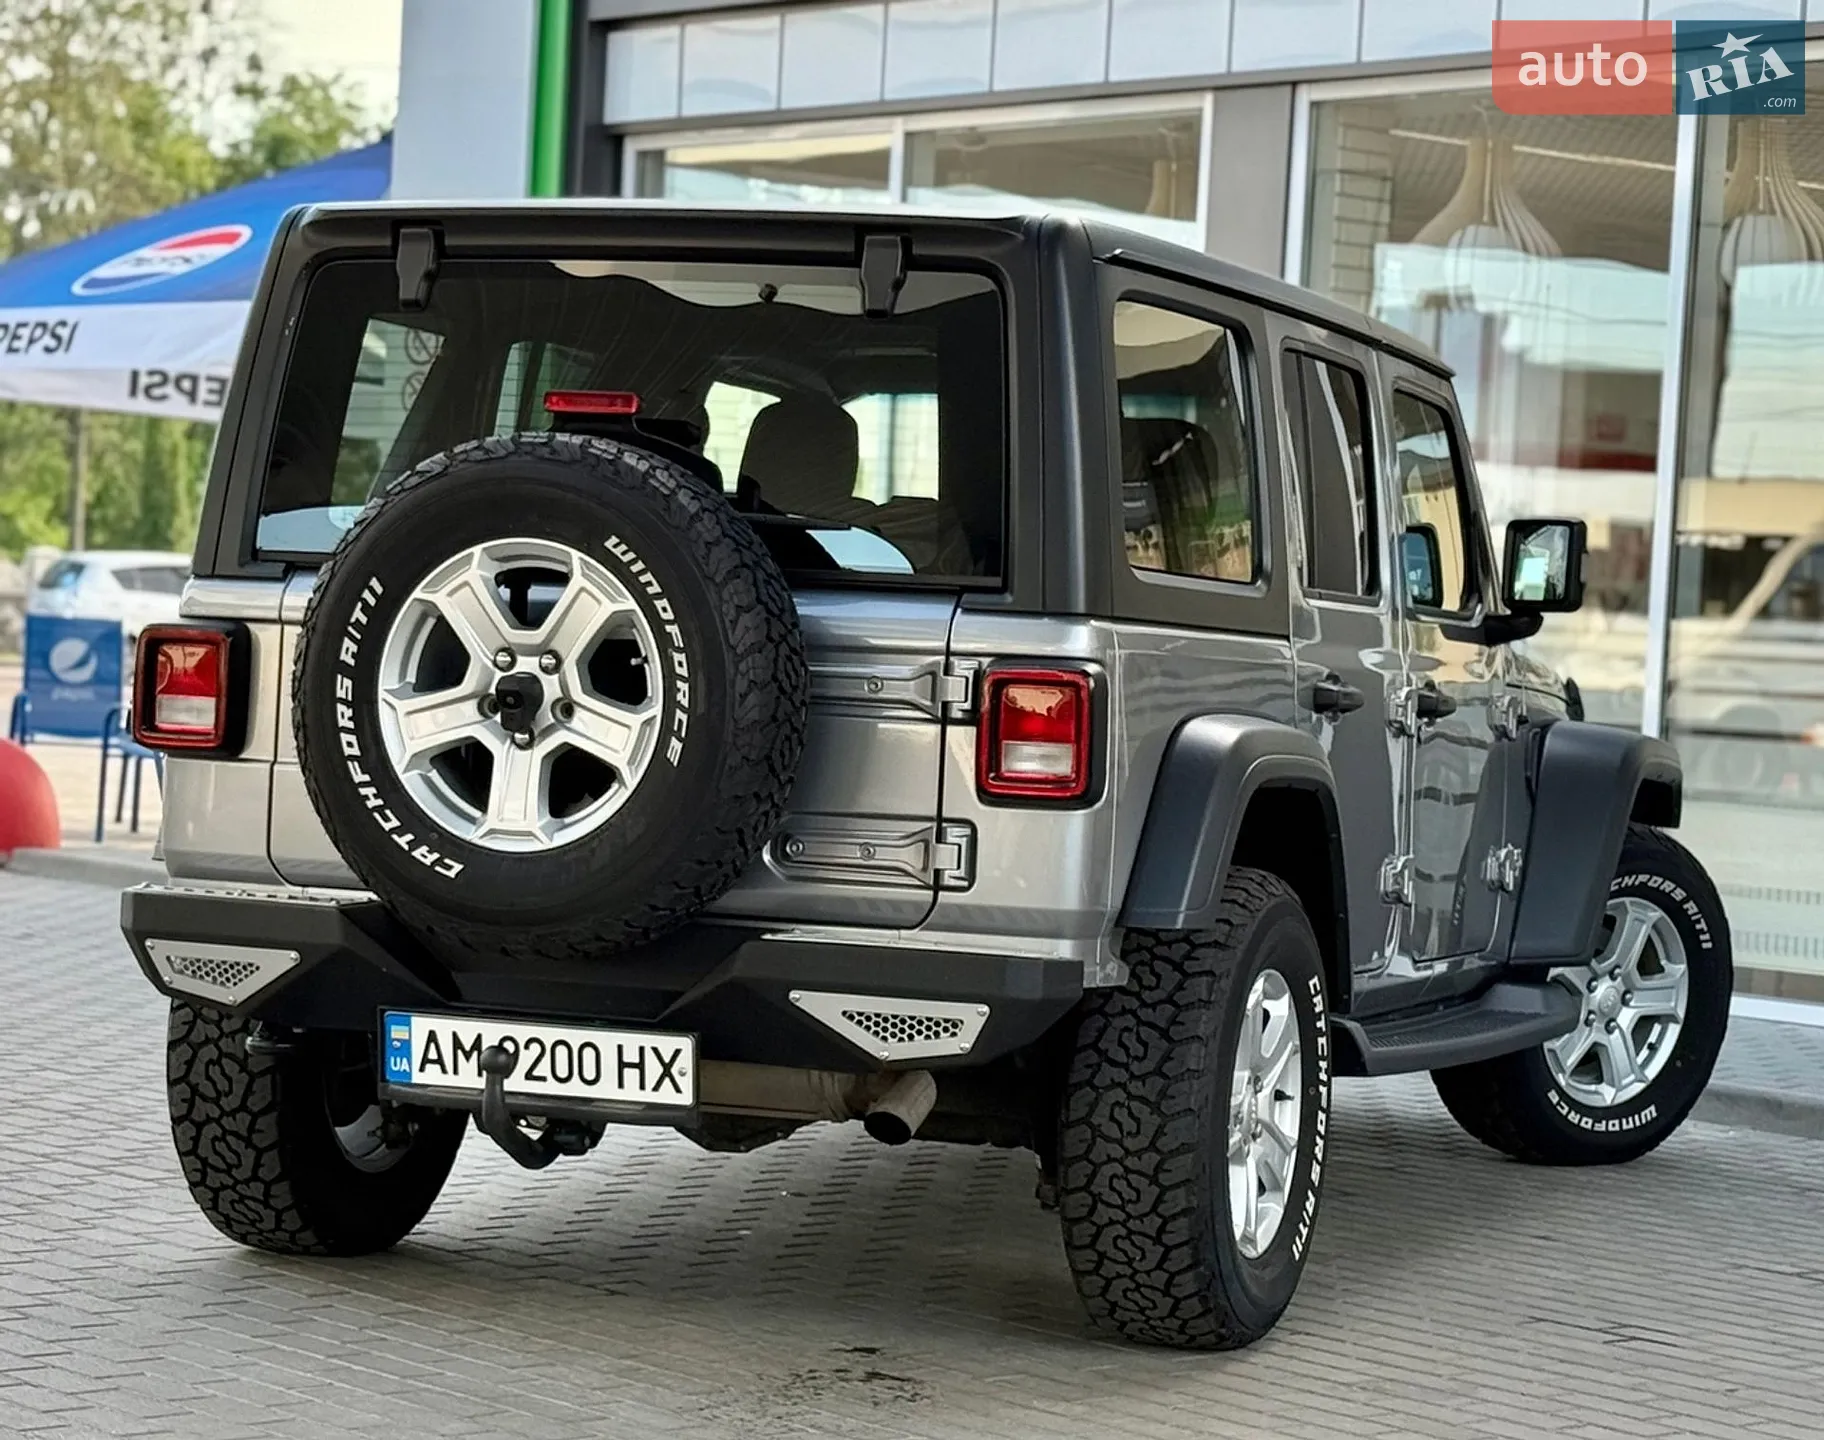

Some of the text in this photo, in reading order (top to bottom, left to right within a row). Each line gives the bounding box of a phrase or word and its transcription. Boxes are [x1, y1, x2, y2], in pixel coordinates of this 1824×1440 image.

[604, 534, 690, 768] WINDFORCE
[336, 673, 466, 880] CATCHFORS
[390, 1056, 411, 1073] UA
[418, 1029, 484, 1078] AM
[616, 1043, 683, 1094] HX
[1308, 975, 1330, 1188] CATCHFORS
[1547, 1089, 1658, 1132] WINDFORCE
